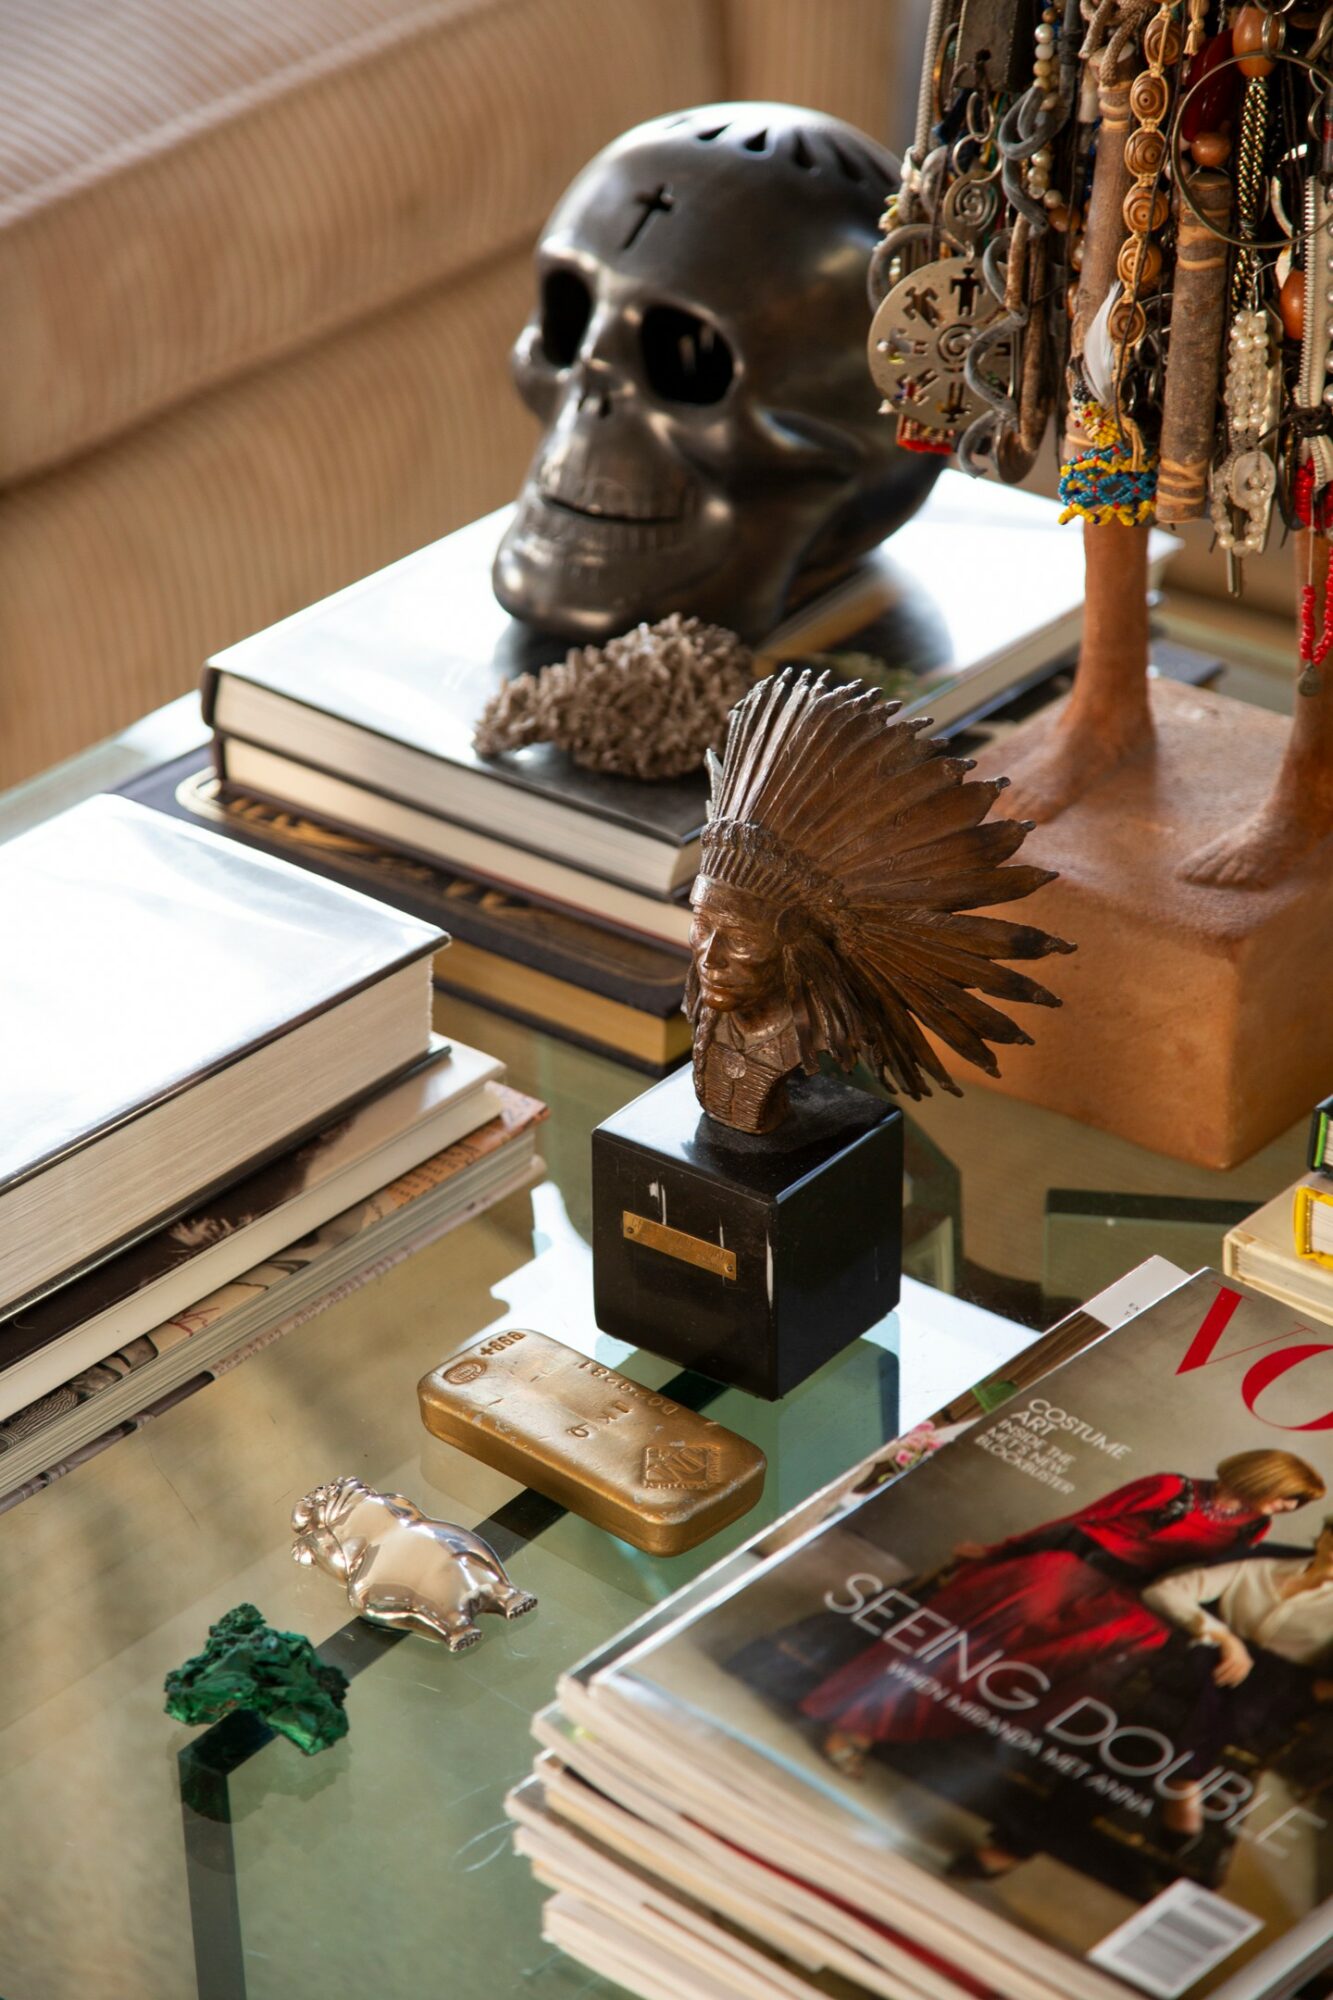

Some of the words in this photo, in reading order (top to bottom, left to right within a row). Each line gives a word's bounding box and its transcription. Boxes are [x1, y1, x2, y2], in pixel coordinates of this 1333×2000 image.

[998, 1419, 1048, 1452] INSIDE
[1046, 1444, 1077, 1467] THE
[1010, 1410, 1060, 1438] ART
[1028, 1399, 1133, 1461] COSTUME
[974, 1434, 1077, 1496] BLOCKBUSTER
[1027, 1450, 1070, 1476] NEW
[823, 1572, 1051, 1711] SEEING
[1043, 1696, 1329, 1860] DOUBLE
[886, 1659, 951, 1702] WHEN
[945, 1694, 1044, 1757] MIRANDA
[1041, 1746, 1093, 1780] MET
[1084, 1773, 1155, 1819] ANNA
